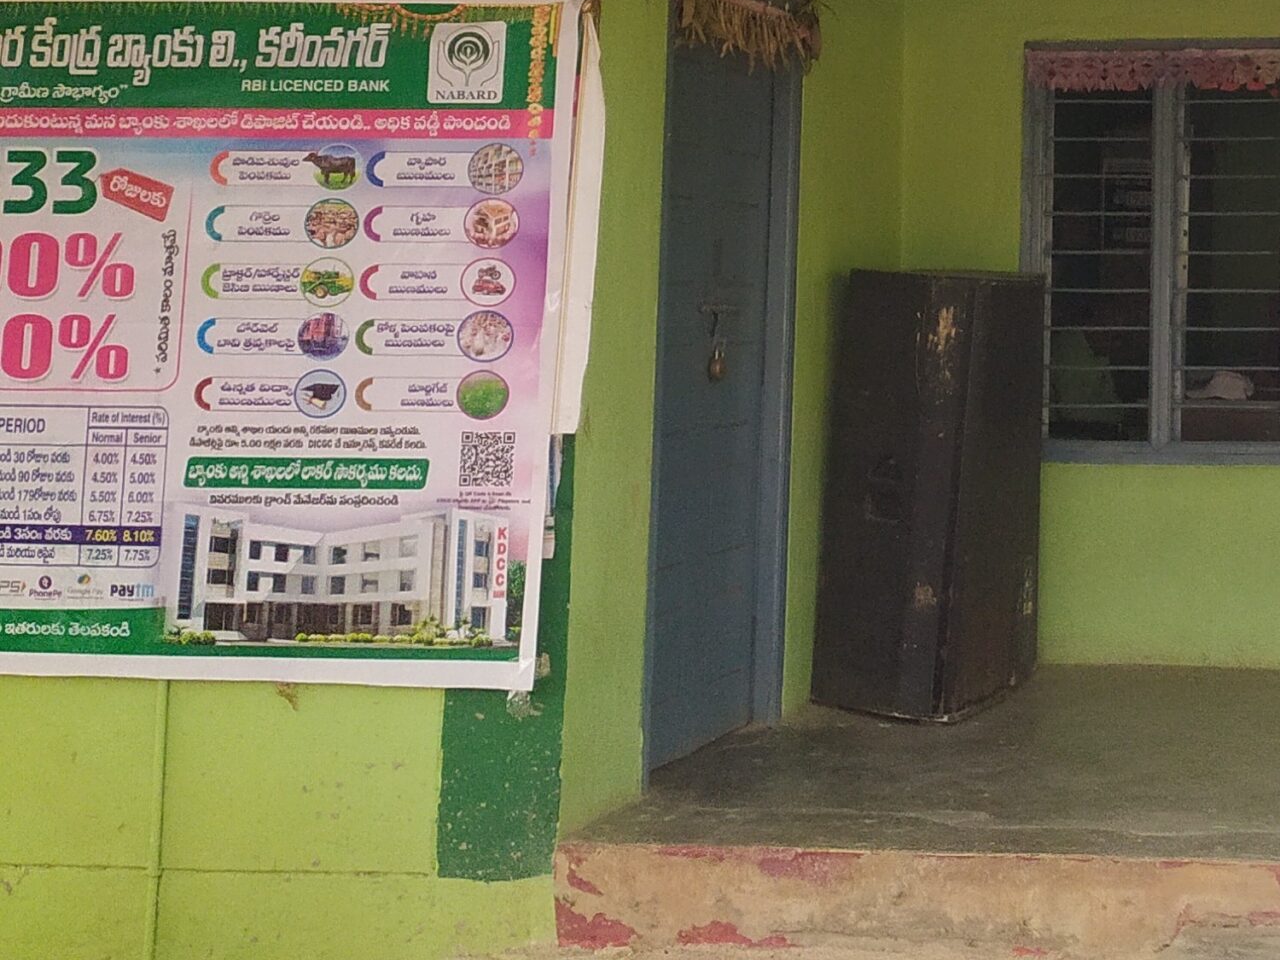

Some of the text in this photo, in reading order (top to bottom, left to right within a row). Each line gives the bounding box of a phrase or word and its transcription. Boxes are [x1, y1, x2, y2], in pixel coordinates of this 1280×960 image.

[29, 16, 103, 76] కేంద్ర
[106, 25, 206, 87] బ్యాంకు
[254, 22, 392, 69] కరీంనగర్
[241, 79, 390, 92] RBI LICENCED BANK
[435, 90, 498, 101] NABARD
[84, 115, 116, 130] మన
[118, 114, 169, 136] బ్యాంకు
[173, 111, 238, 131] శాఖలలో
[240, 112, 301, 131] డిపాజిట్
[374, 116, 411, 133] అధిక
[0, 232, 135, 298] 0%
[91, 411, 111, 424] Rate
[111, 411, 120, 423] of
[91, 433, 123, 444] Normal
[132, 432, 162, 444] Senior
[93, 452, 120, 465] 4.00%
[130, 453, 157, 466] 4.50%
[91, 471, 118, 484] 4.50%
[129, 472, 155, 485] 5.00%
[188, 463, 228, 486] బ్యాంకు
[229, 464, 249, 485] అన్ని
[250, 459, 301, 483] శాఖలలో
[301, 460, 333, 481] లాకర్
[90, 491, 117, 503] 5.50%
[128, 491, 154, 503] 6.00%
[88, 510, 115, 523] 6.75%
[126, 510, 153, 523] 7.25%
[85, 529, 118, 542] 7.60%
[122, 530, 154, 543] 8.10%
[86, 548, 114, 561] 7.25%
[124, 549, 151, 562] 7.75%
[495, 527, 507, 587] KDCC
[29, 589, 63, 599] PhonePe
